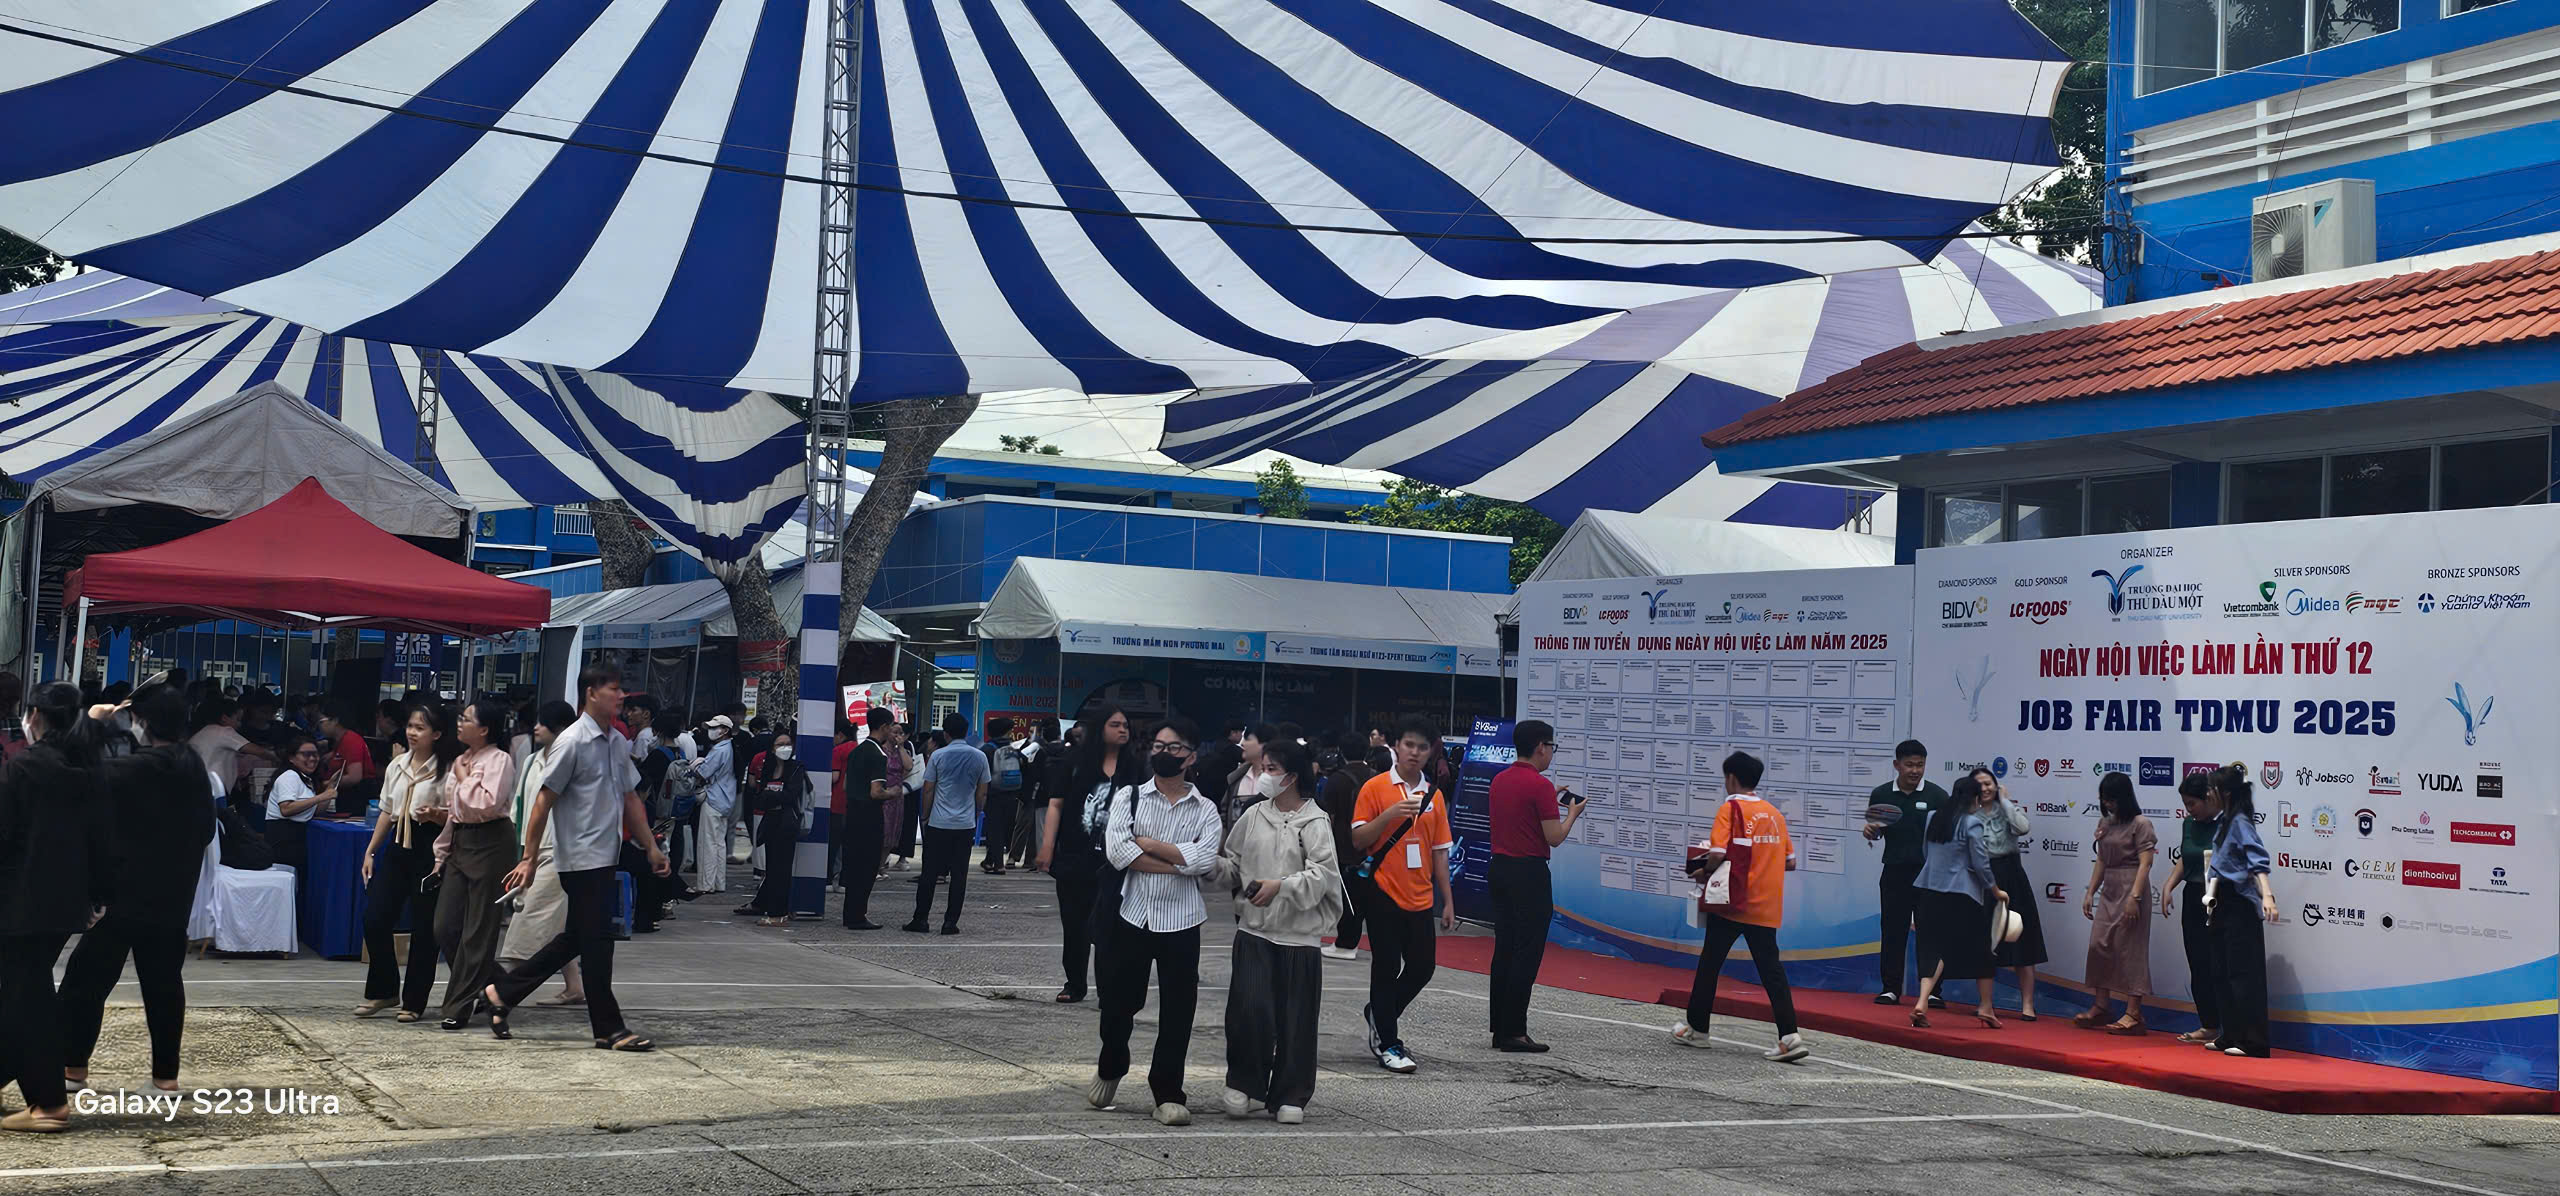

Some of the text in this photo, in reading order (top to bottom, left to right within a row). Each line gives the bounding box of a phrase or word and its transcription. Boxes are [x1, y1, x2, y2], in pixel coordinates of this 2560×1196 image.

[2121, 547, 2174, 559] ORGANIZER
[2274, 565, 2350, 577] SILVER SPONSORS
[2428, 566, 2521, 579] BRONZE SPONSORS
[1969, 577, 1998, 587] SPONSOR
[2014, 576, 2068, 587] GOLD SPONSOR
[2290, 593, 2340, 614] Midea
[2447, 592, 2525, 604] Chứng Khoán
[1942, 600, 1976, 619] BIDV
[2010, 600, 2068, 617] LC FOODS
[2223, 602, 2279, 613] Vietcombank
[2506, 601, 2530, 609] Nam
[1563, 607, 1582, 619] BIDV
[1607, 609, 1629, 619] FOODS
[395, 641, 431, 655] FAIR
[1163, 640, 1178, 648] NON
[1211, 641, 1225, 650] MAI
[1534, 631, 1888, 653] THÔNG TIN TUYỂN DỤNG NGÀY HỘI VIỆC LÀM NĂM 2025
[2040, 633, 2373, 682] NGÀY HỘI VIỆC LÀM LẦN THỨ 12
[2018, 699, 2396, 736] JOB FAIR TDMU 2025
[2314, 773, 2354, 784] JobsGO
[2418, 773, 2463, 792] YUDA
[2036, 803, 2068, 813] HDBank
[2283, 814, 2298, 828] LC
[2453, 829, 2497, 838] TECHCOMBANK
